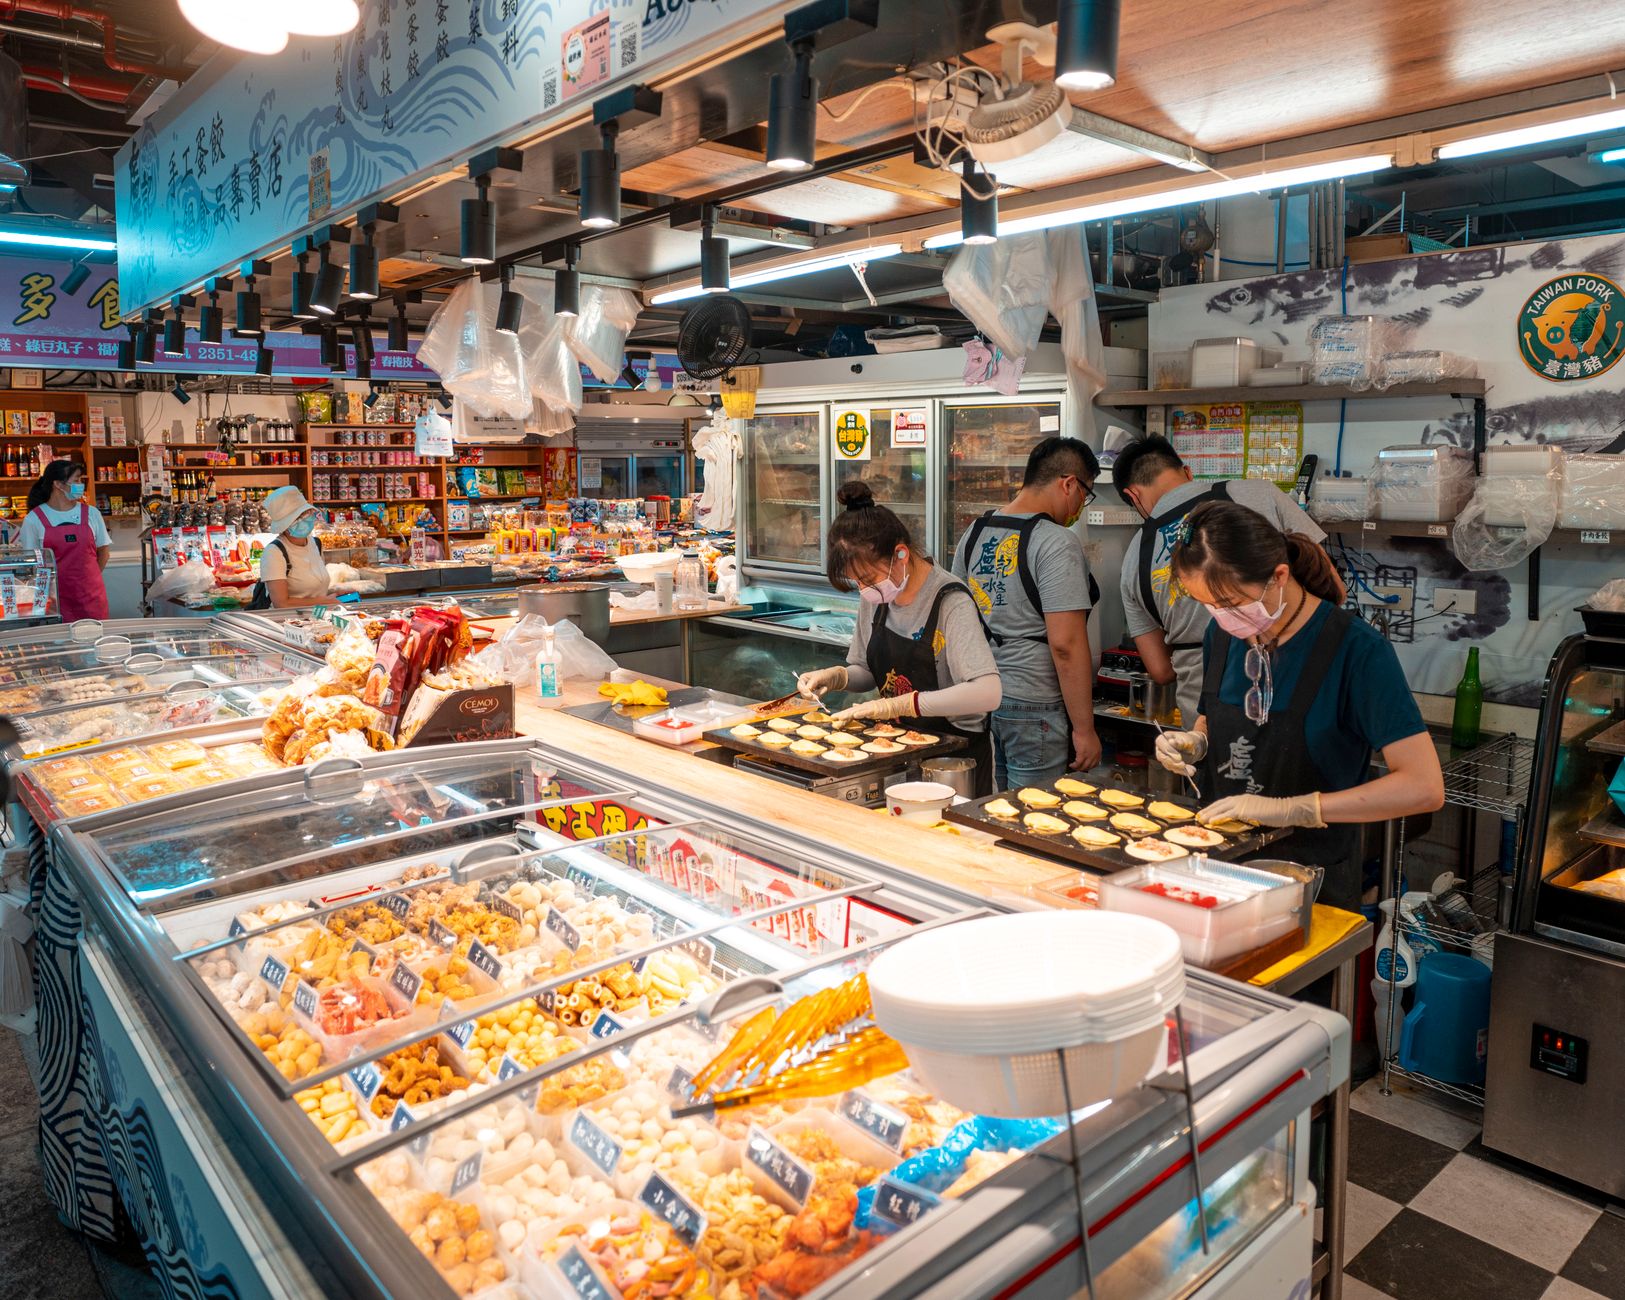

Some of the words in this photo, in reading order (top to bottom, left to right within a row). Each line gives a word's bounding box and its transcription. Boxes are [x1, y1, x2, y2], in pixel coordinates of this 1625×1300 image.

[1526, 278, 1573, 316] TAIWAN
[1576, 278, 1615, 302] PORK
[1543, 356, 1603, 378] 臺灣豬
